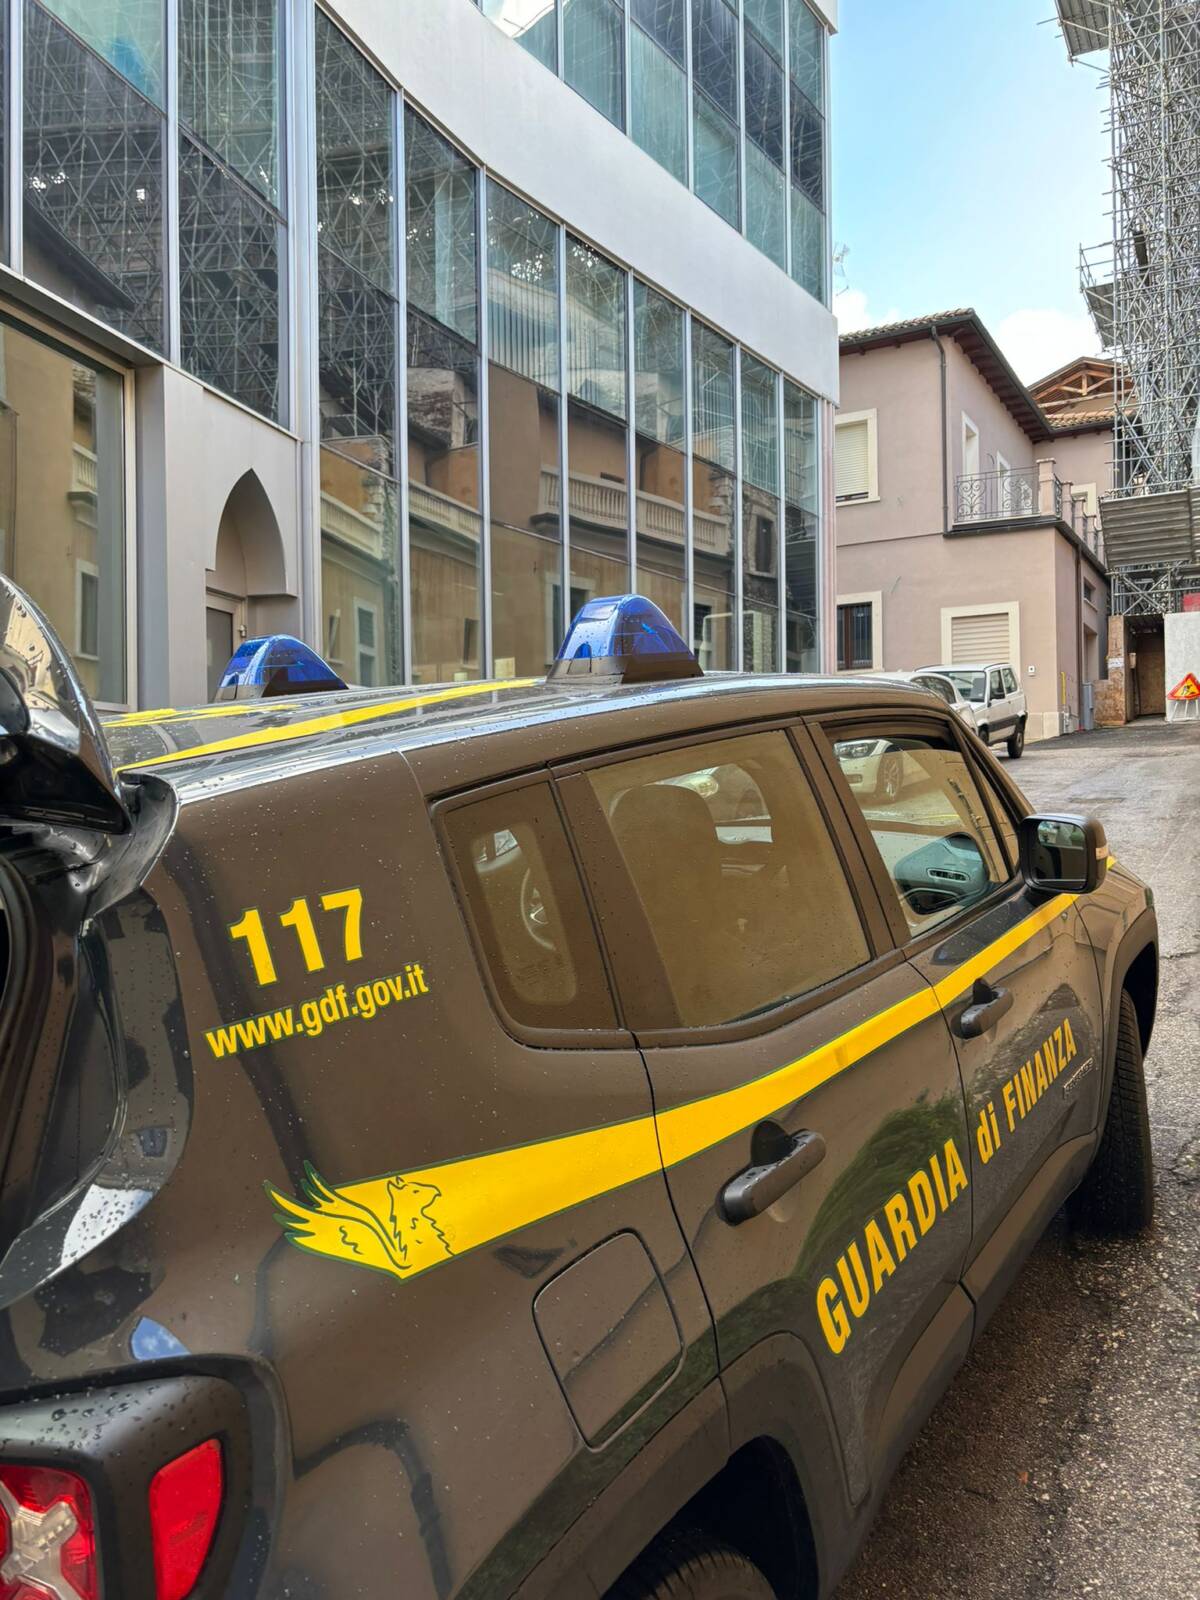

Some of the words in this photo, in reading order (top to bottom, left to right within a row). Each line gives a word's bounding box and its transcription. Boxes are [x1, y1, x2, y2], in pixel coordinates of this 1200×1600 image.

[229, 888, 364, 986] 117
[204, 963, 430, 1058] www.gdf.gov.it
[816, 1137, 969, 1355] GUARDIA
[976, 1102, 1001, 1164] di
[1001, 1018, 1077, 1132] FINANZA
